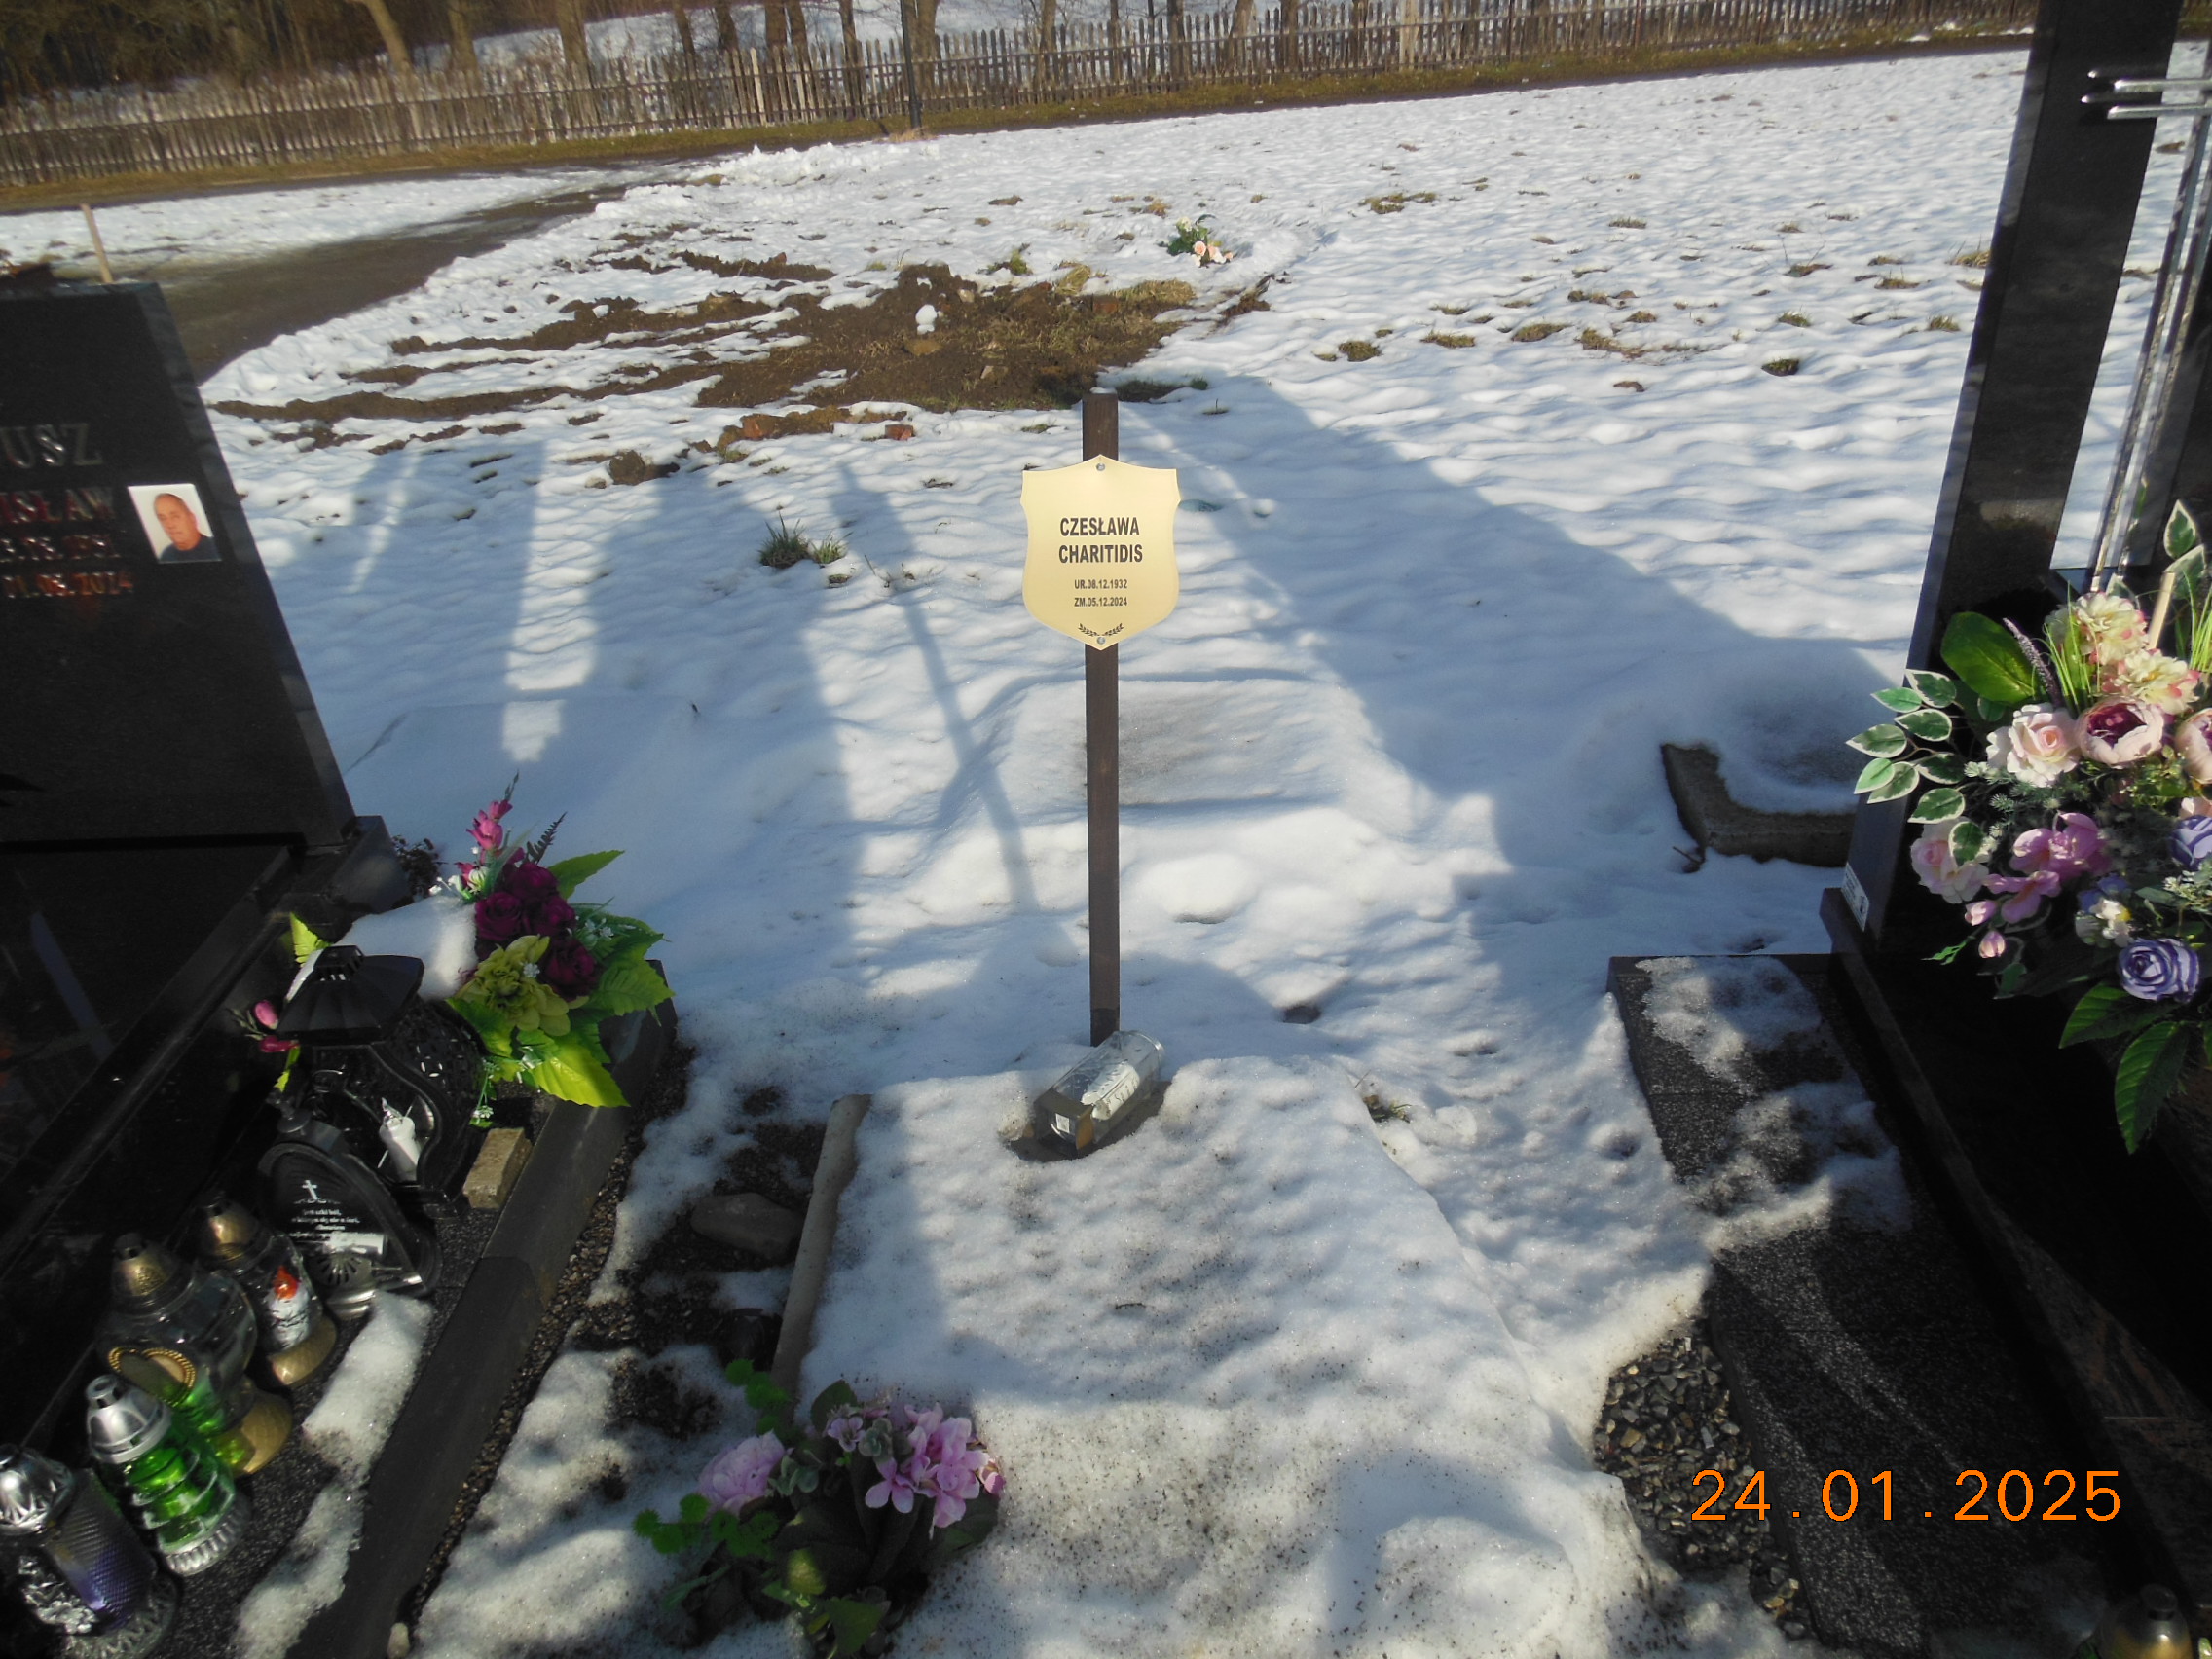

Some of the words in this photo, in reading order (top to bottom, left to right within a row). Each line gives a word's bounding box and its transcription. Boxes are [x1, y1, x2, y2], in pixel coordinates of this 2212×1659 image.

[1059, 516, 1140, 537] CZESŁAWA
[1058, 544, 1143, 564] CHARITIDIS
[1074, 578, 1128, 590] UR.08.12.1932
[1074, 596, 1128, 608] ZM.05.12.2024
